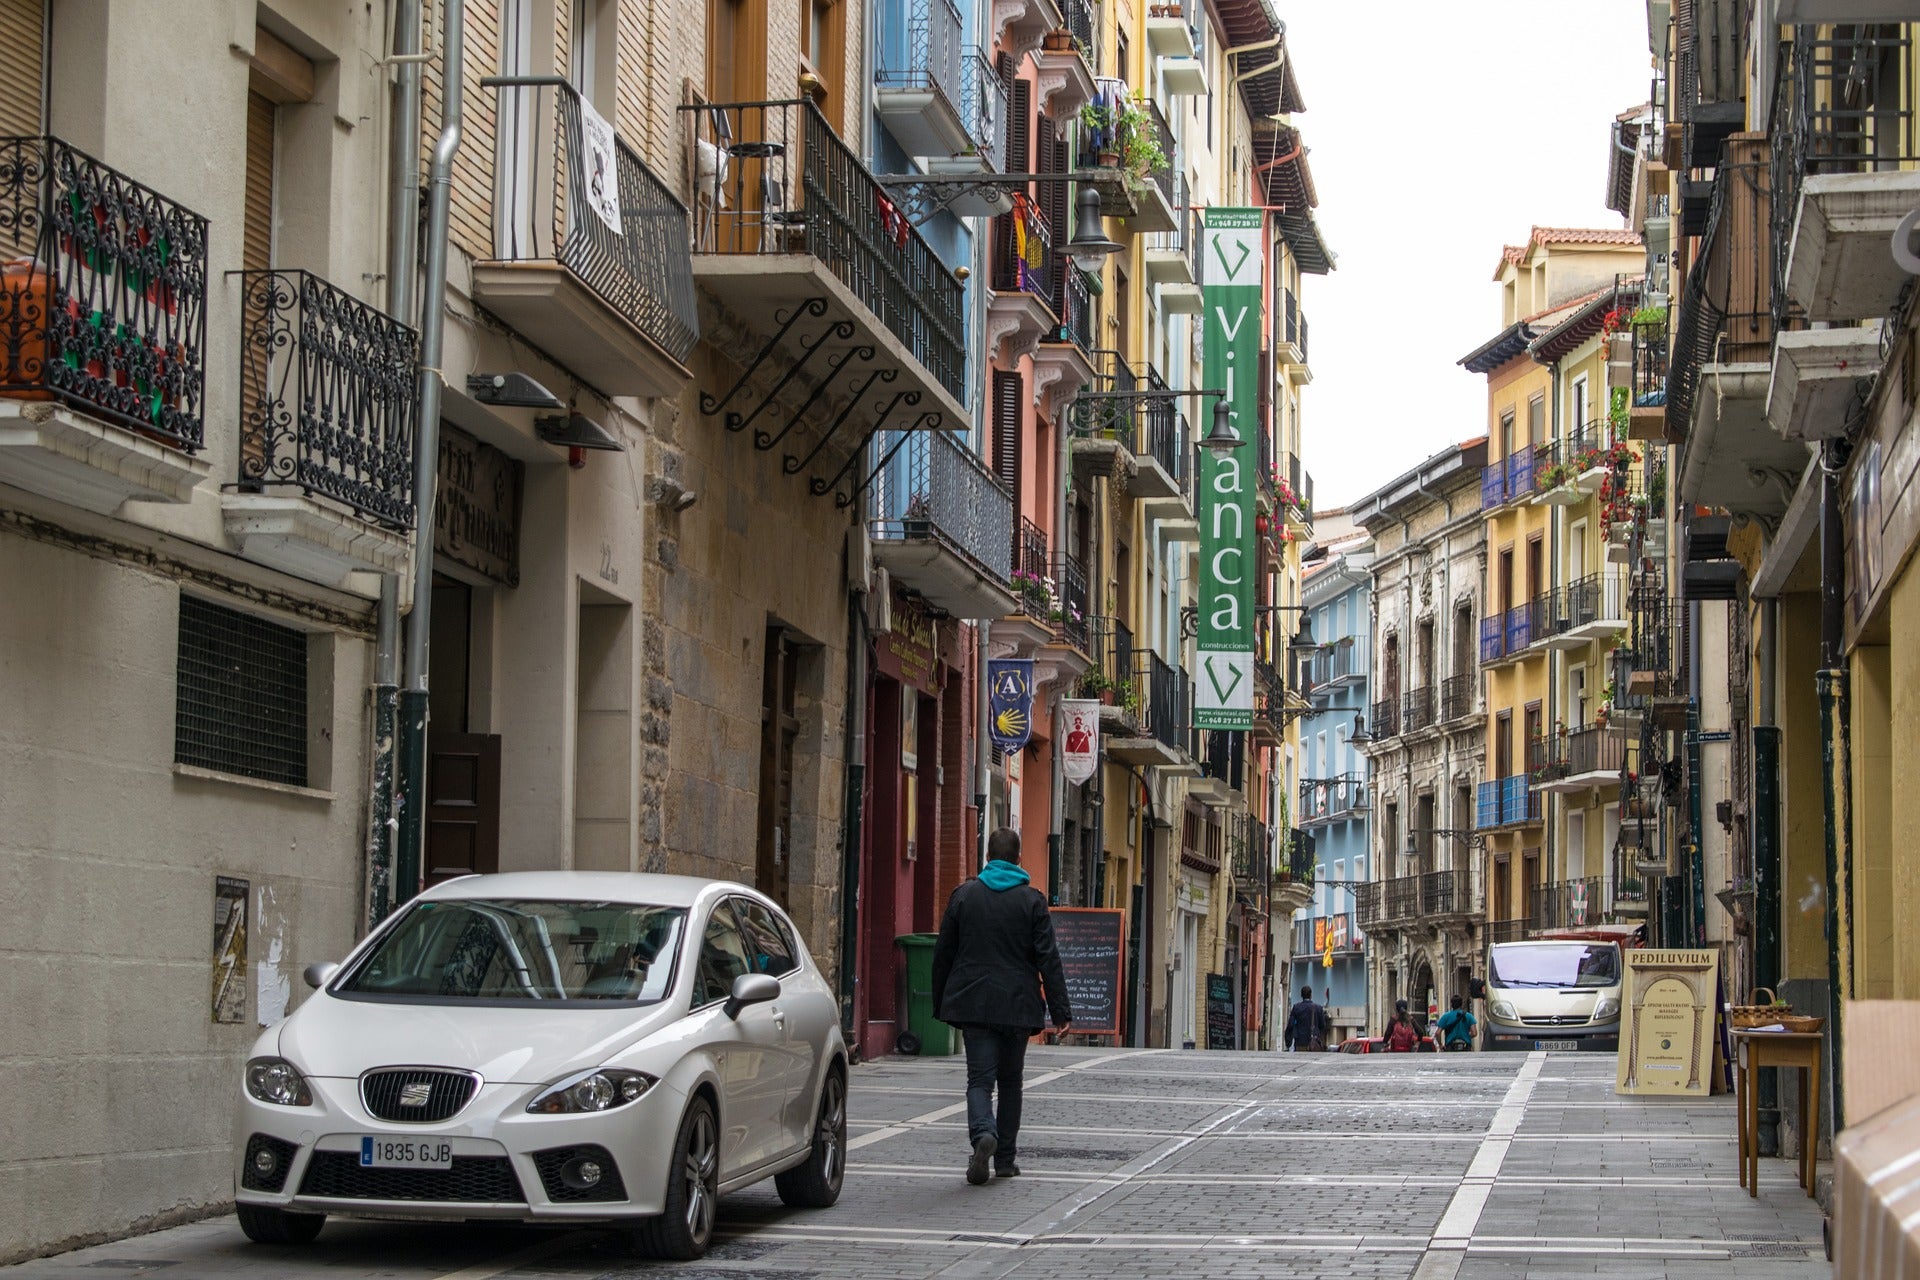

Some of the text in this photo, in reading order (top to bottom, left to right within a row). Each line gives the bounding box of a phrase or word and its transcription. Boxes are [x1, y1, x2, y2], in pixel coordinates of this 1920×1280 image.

[1201, 641, 1250, 650] construcciones
[1001, 675, 1018, 694] A
[1208, 717, 1222, 725] 948
[1632, 953, 1711, 964] PEDILUVIUM
[377, 1142, 415, 1161] 1835
[419, 1144, 451, 1162] GJB
